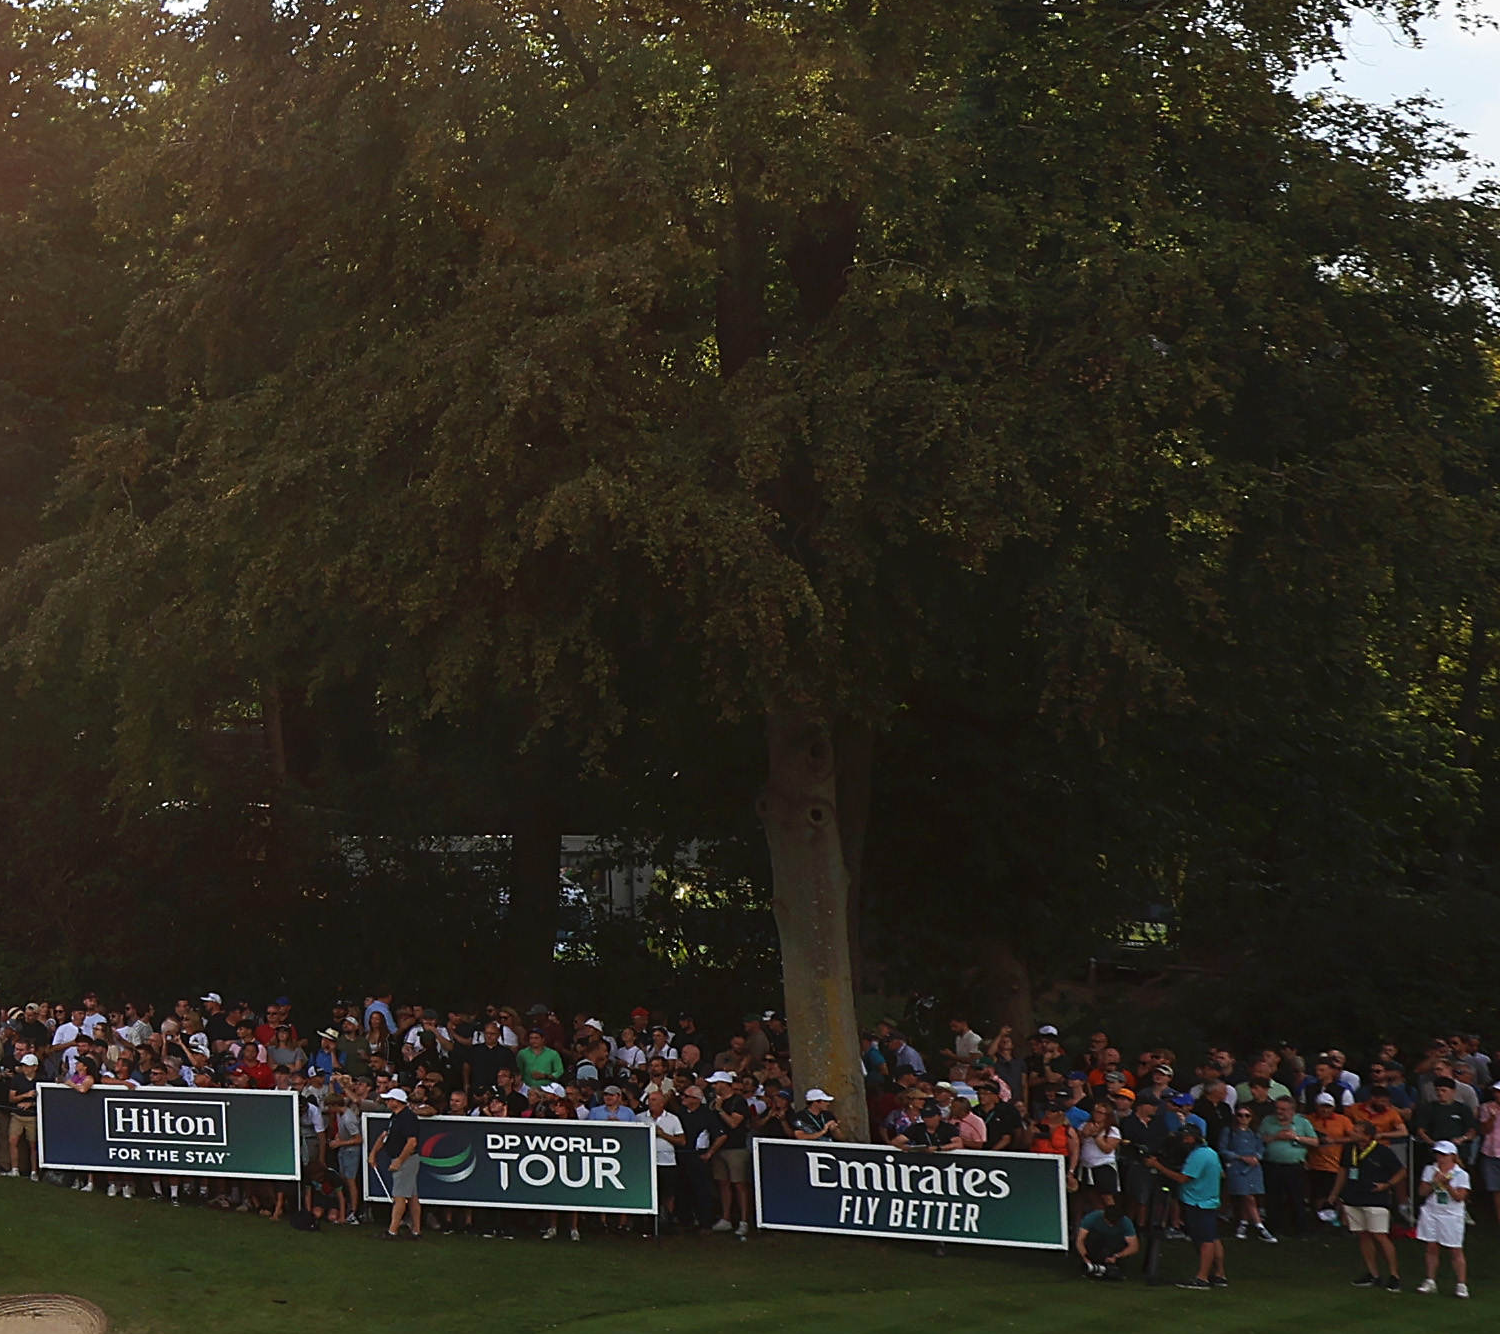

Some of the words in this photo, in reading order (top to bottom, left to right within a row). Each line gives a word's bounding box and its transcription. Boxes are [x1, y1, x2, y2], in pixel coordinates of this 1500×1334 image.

[115, 1107, 216, 1136] Hilton
[109, 1147, 141, 1161] FOR
[146, 1149, 179, 1163] THE
[486, 1134, 521, 1150] DP
[524, 1135, 621, 1154] WORLD
[488, 1153, 625, 1191] TOUR
[806, 1151, 1011, 1199] Emirates
[839, 1195, 881, 1225] FLY
[888, 1199, 980, 1233] BETTER
